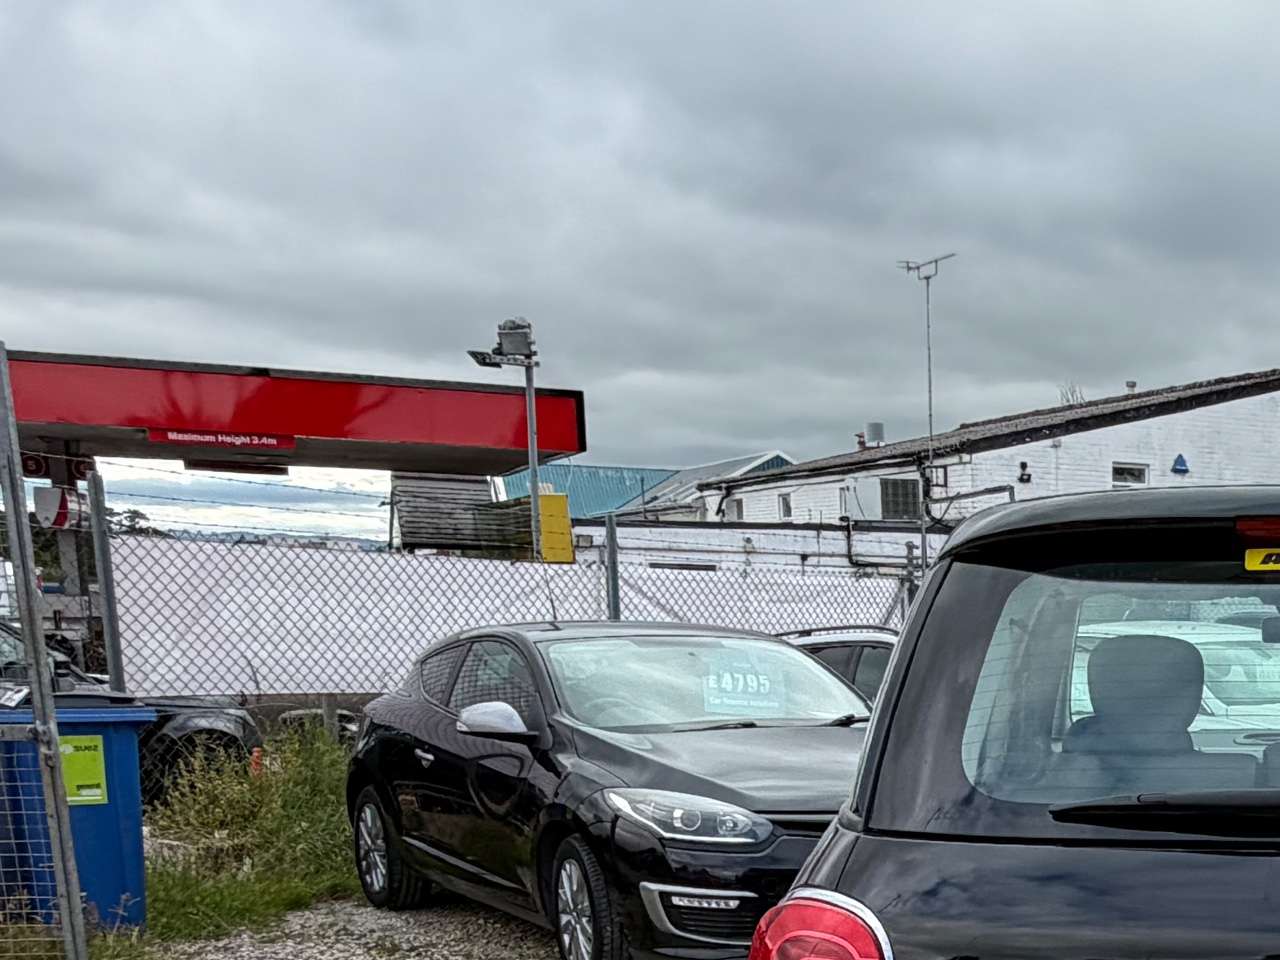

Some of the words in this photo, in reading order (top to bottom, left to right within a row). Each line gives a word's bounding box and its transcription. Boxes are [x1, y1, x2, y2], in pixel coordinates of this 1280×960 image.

[167, 432, 216, 442] Maximum
[218, 434, 250, 445] Height
[251, 436, 277, 445] 3.4m
[708, 672, 770, 693] £4795
